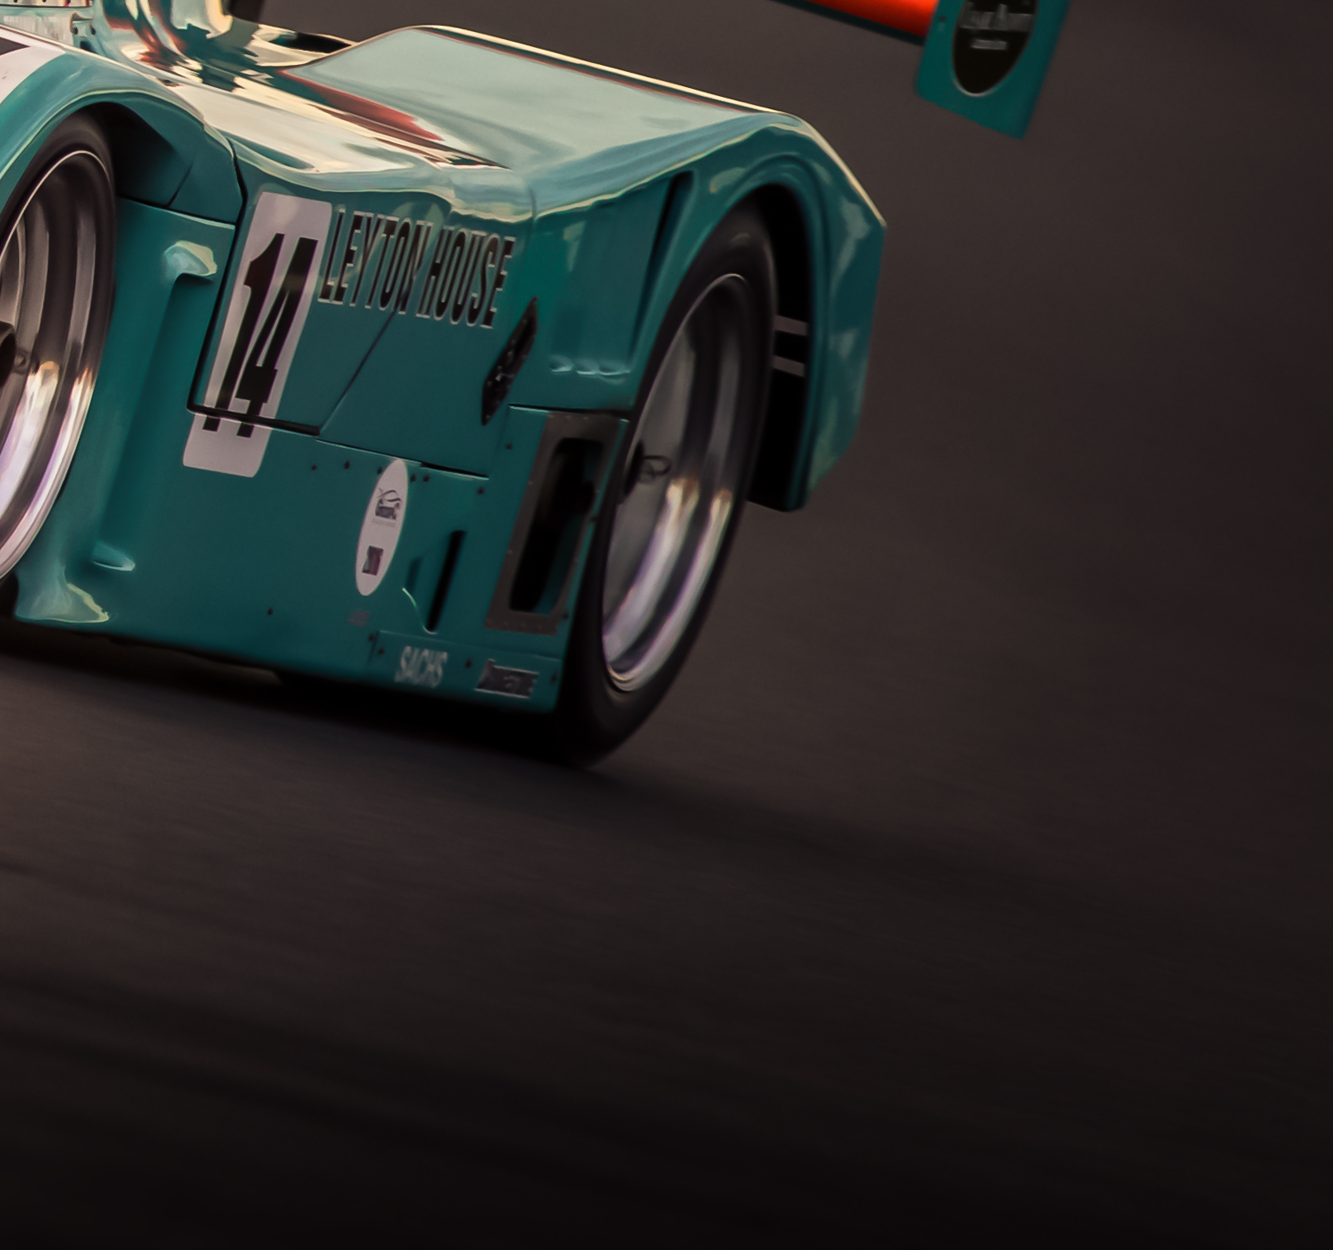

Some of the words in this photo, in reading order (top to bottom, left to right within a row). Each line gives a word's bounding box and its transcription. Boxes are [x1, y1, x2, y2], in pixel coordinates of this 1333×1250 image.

[202, 232, 319, 439] 14
[318, 209, 433, 316] LEYTON
[415, 224, 516, 330] HOUSE
